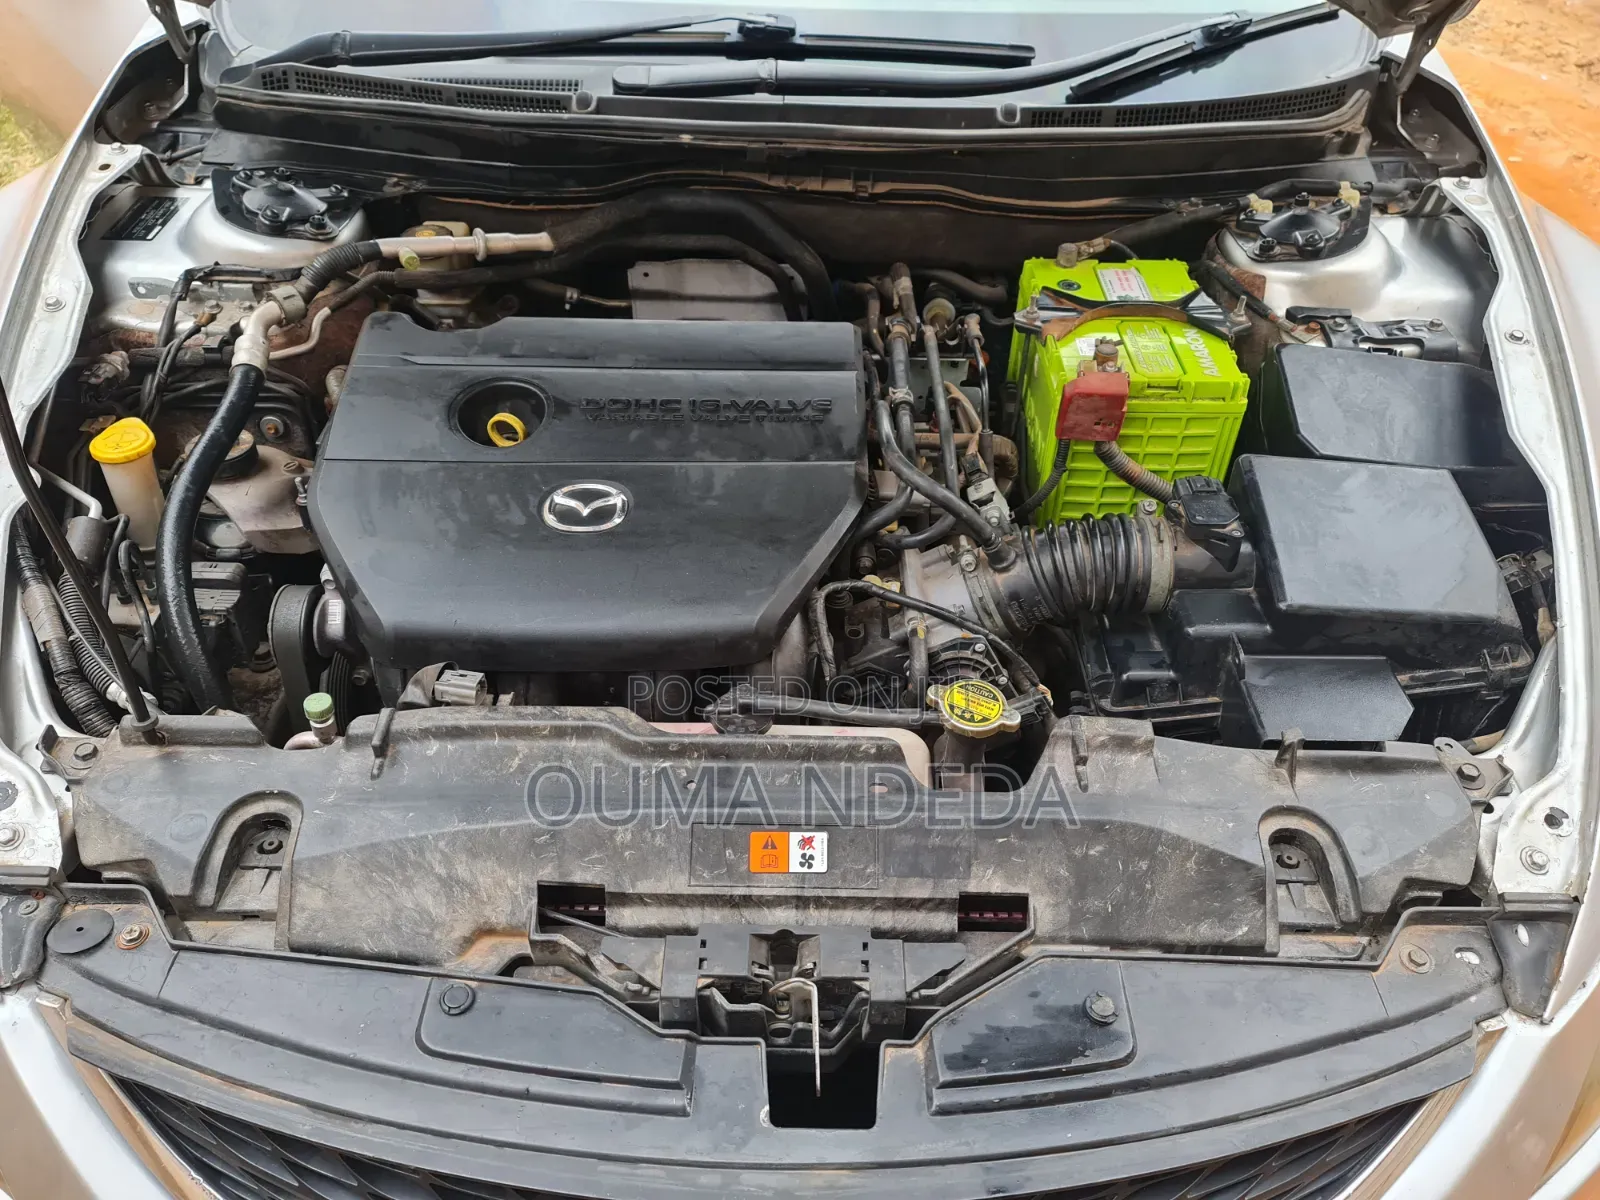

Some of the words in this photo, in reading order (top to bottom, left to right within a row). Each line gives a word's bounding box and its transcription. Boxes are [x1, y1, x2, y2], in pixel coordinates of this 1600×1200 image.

[1183, 328, 1222, 377] AMARON
[580, 398, 682, 411] DOHC
[585, 412, 684, 422] VARIABLE
[689, 412, 751, 422] VALVE
[965, 684, 994, 698] CAUTION
